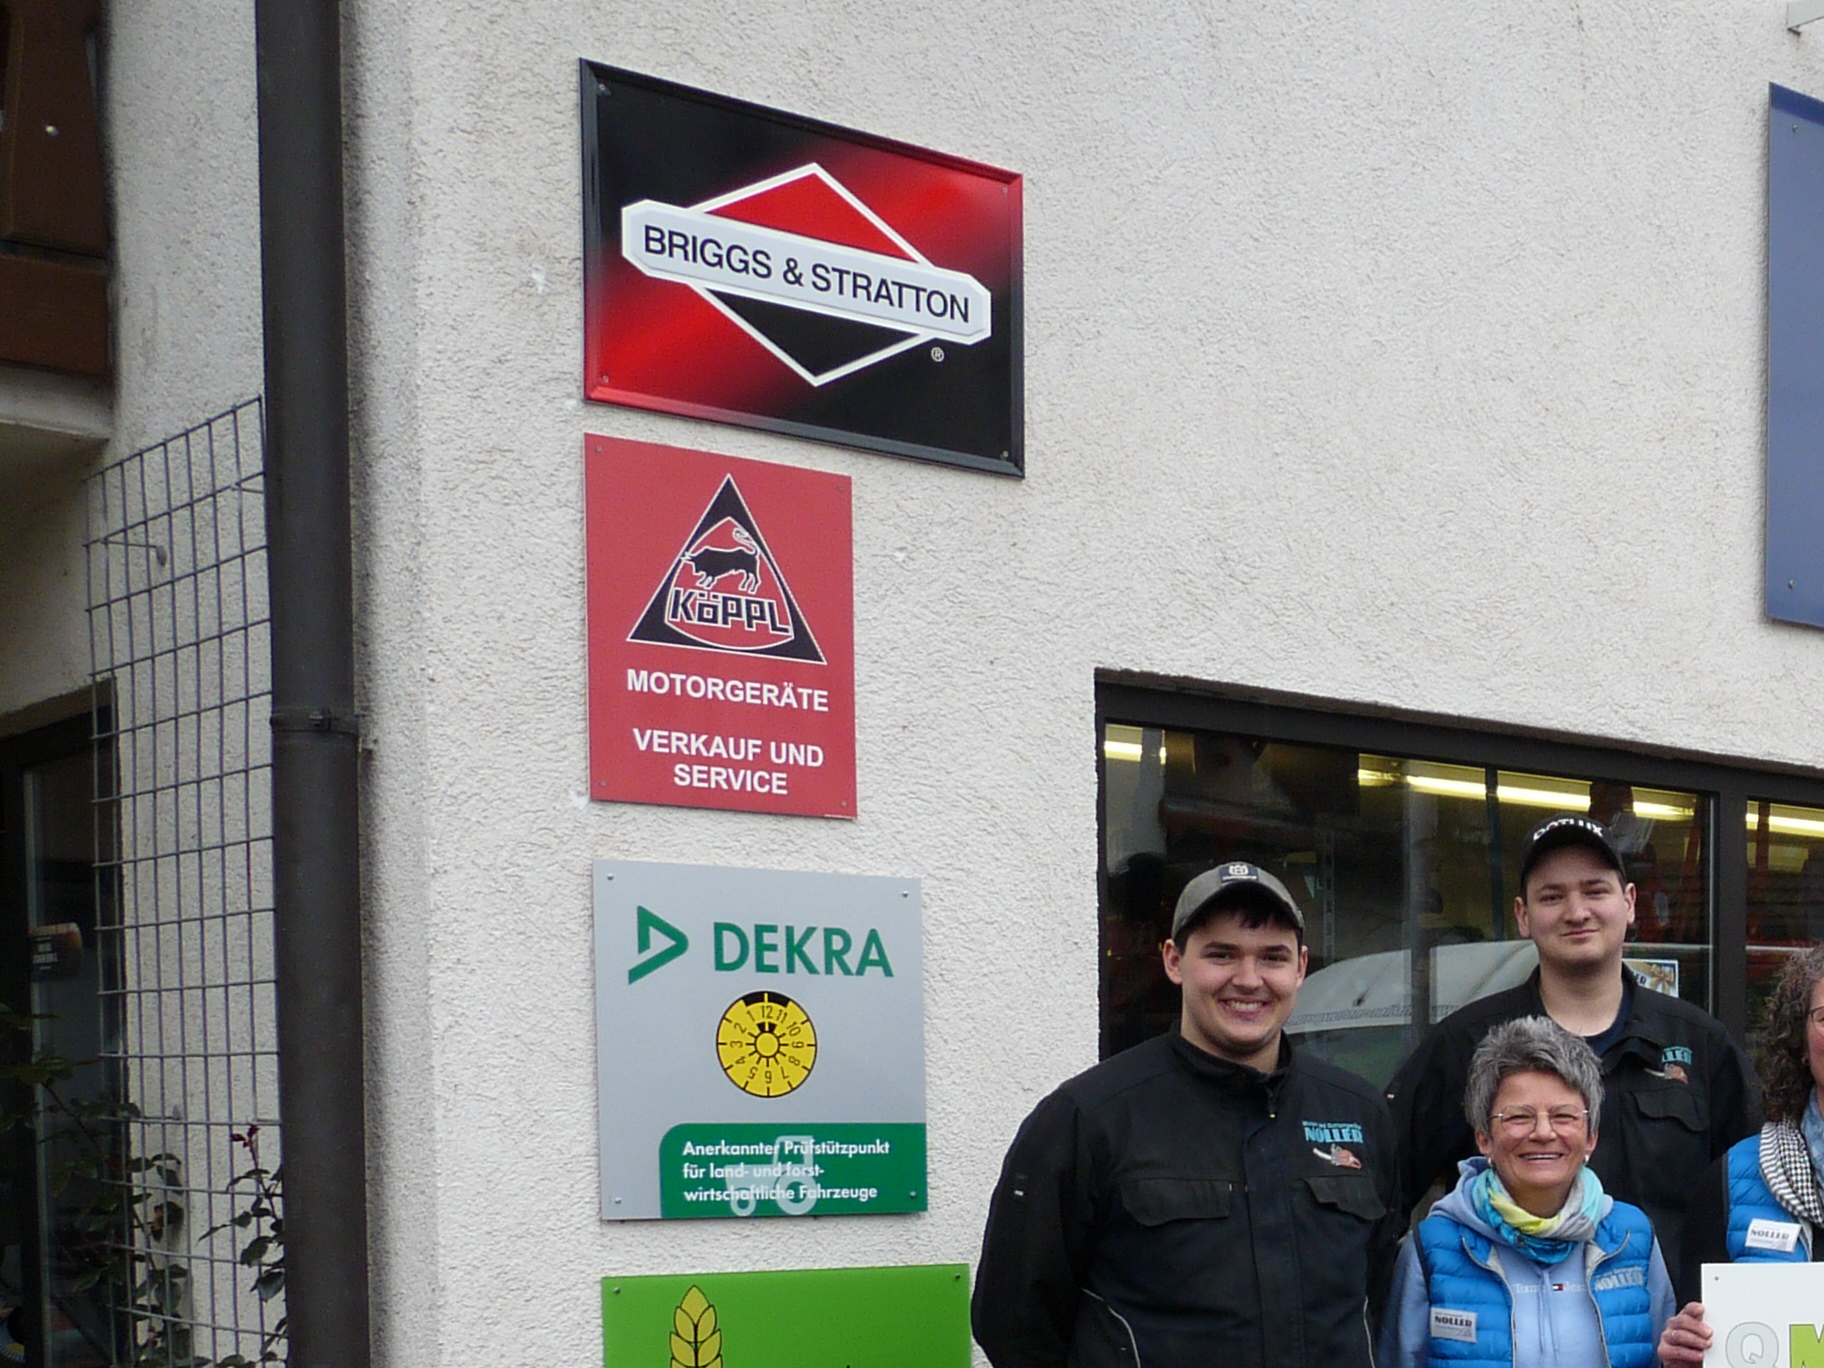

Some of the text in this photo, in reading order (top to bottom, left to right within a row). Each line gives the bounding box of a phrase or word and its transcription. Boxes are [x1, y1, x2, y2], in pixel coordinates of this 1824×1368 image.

[644, 224, 970, 323] BRIGGS & STRATTON
[626, 668, 829, 712] MOTORGERÄTE
[632, 728, 824, 768] VERKAUF UND
[673, 763, 788, 795] SERVICE
[713, 921, 895, 978] DEKRA
[1304, 1127, 1363, 1143] NOLLER
[683, 1140, 890, 1158] Anerkannter Prüfstützpunkt
[683, 1163, 824, 1179] für land- und forst-
[684, 1185, 878, 1202] wirtschaftliche Fahrzeuge
[1434, 1315, 1472, 1327] NOLLER
